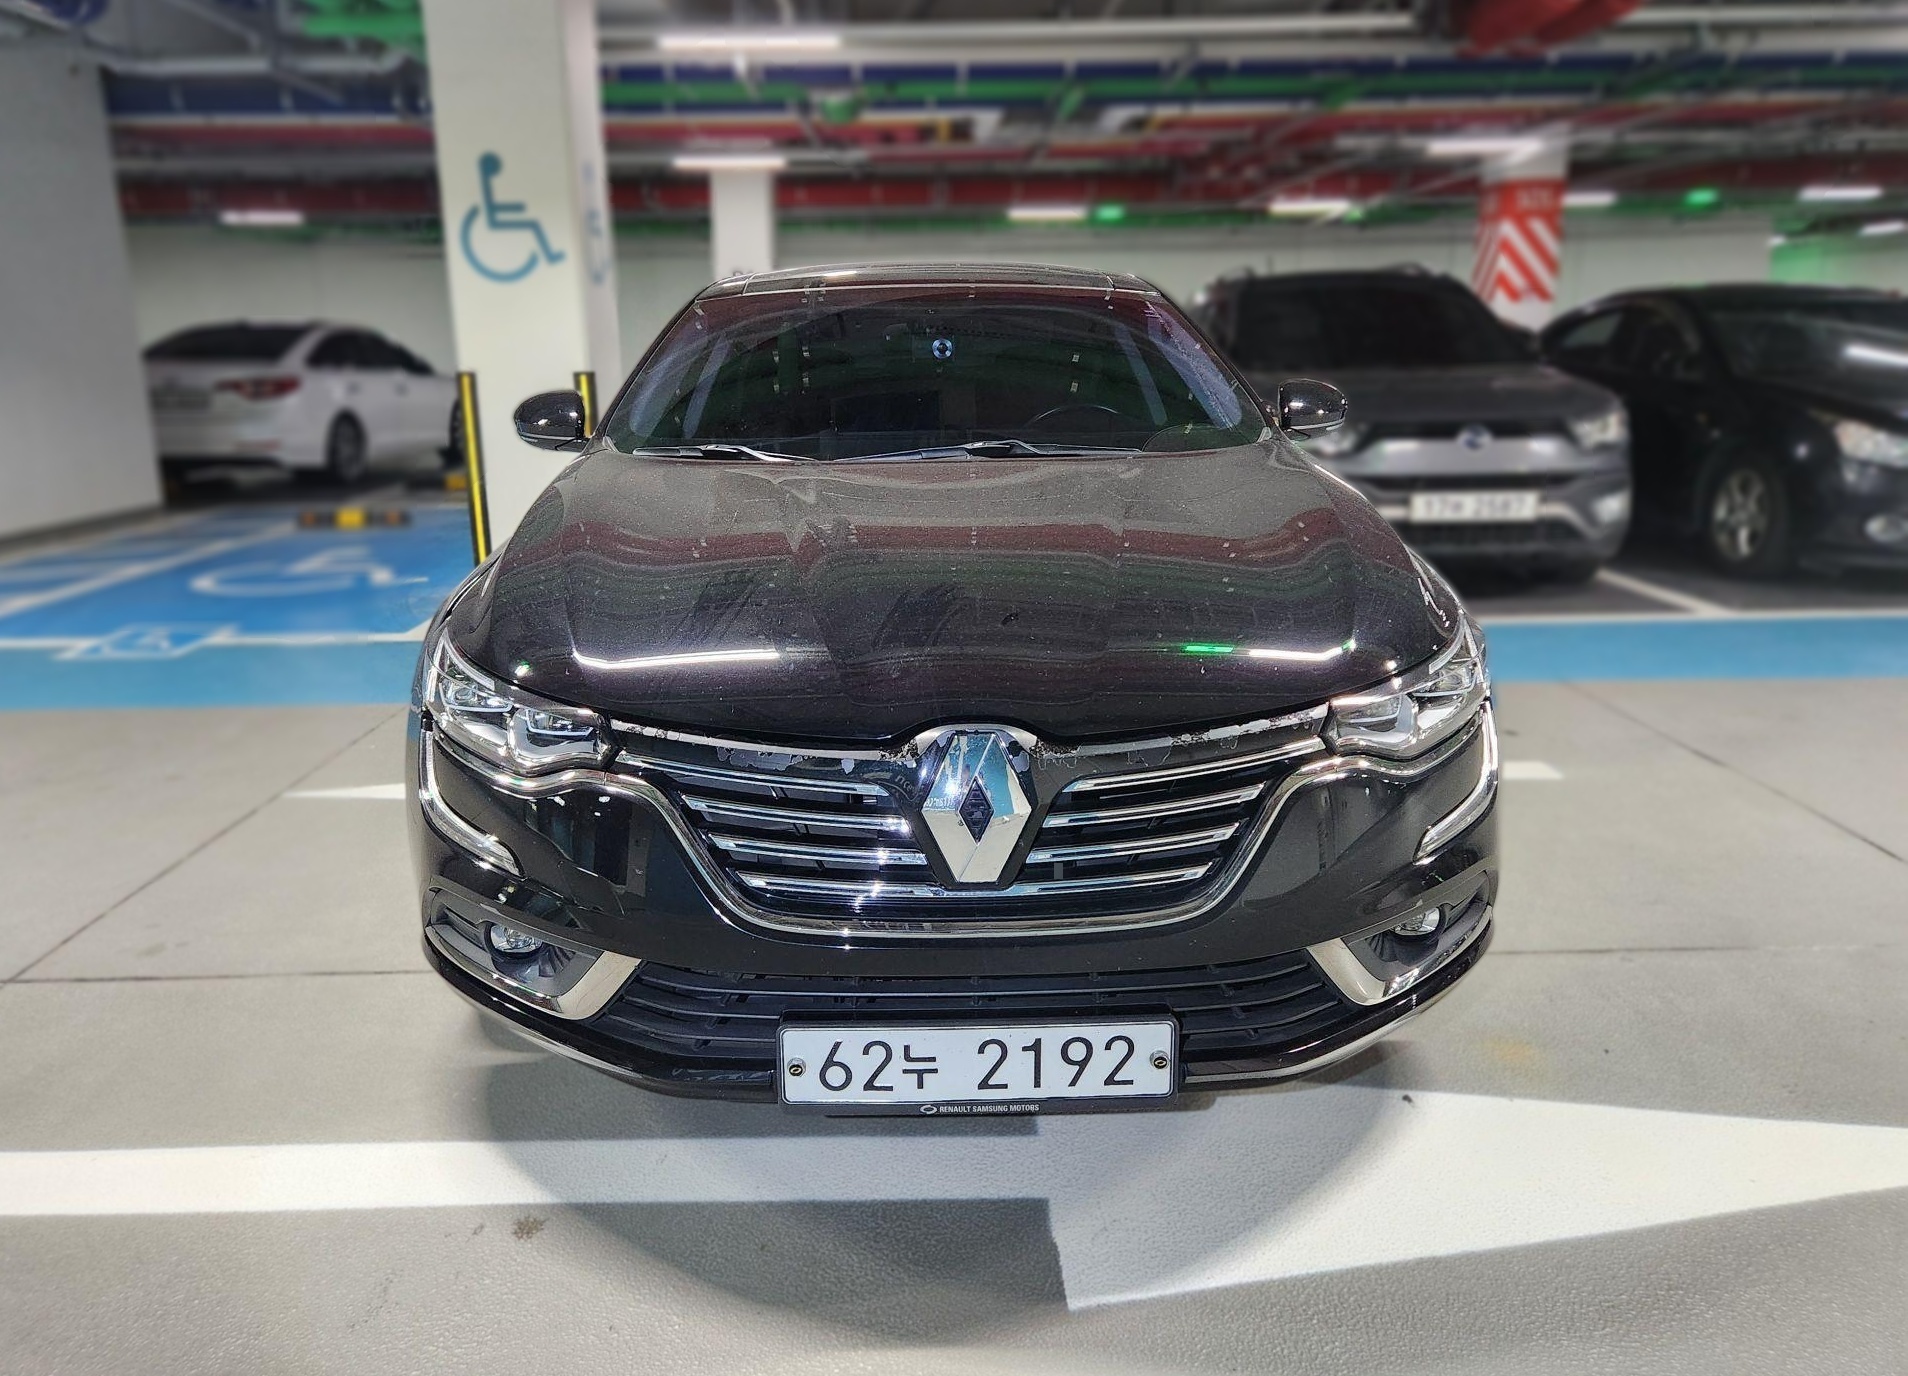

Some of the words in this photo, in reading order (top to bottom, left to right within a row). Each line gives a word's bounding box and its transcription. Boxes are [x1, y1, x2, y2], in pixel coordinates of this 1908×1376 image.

[818, 1039, 939, 1092] 62누
[976, 1034, 1135, 1090] 2192
[939, 1105, 971, 1113] RENAULT
[972, 1104, 1008, 1113] SAMSUNG
[1009, 1104, 1040, 1112] MOTORS
